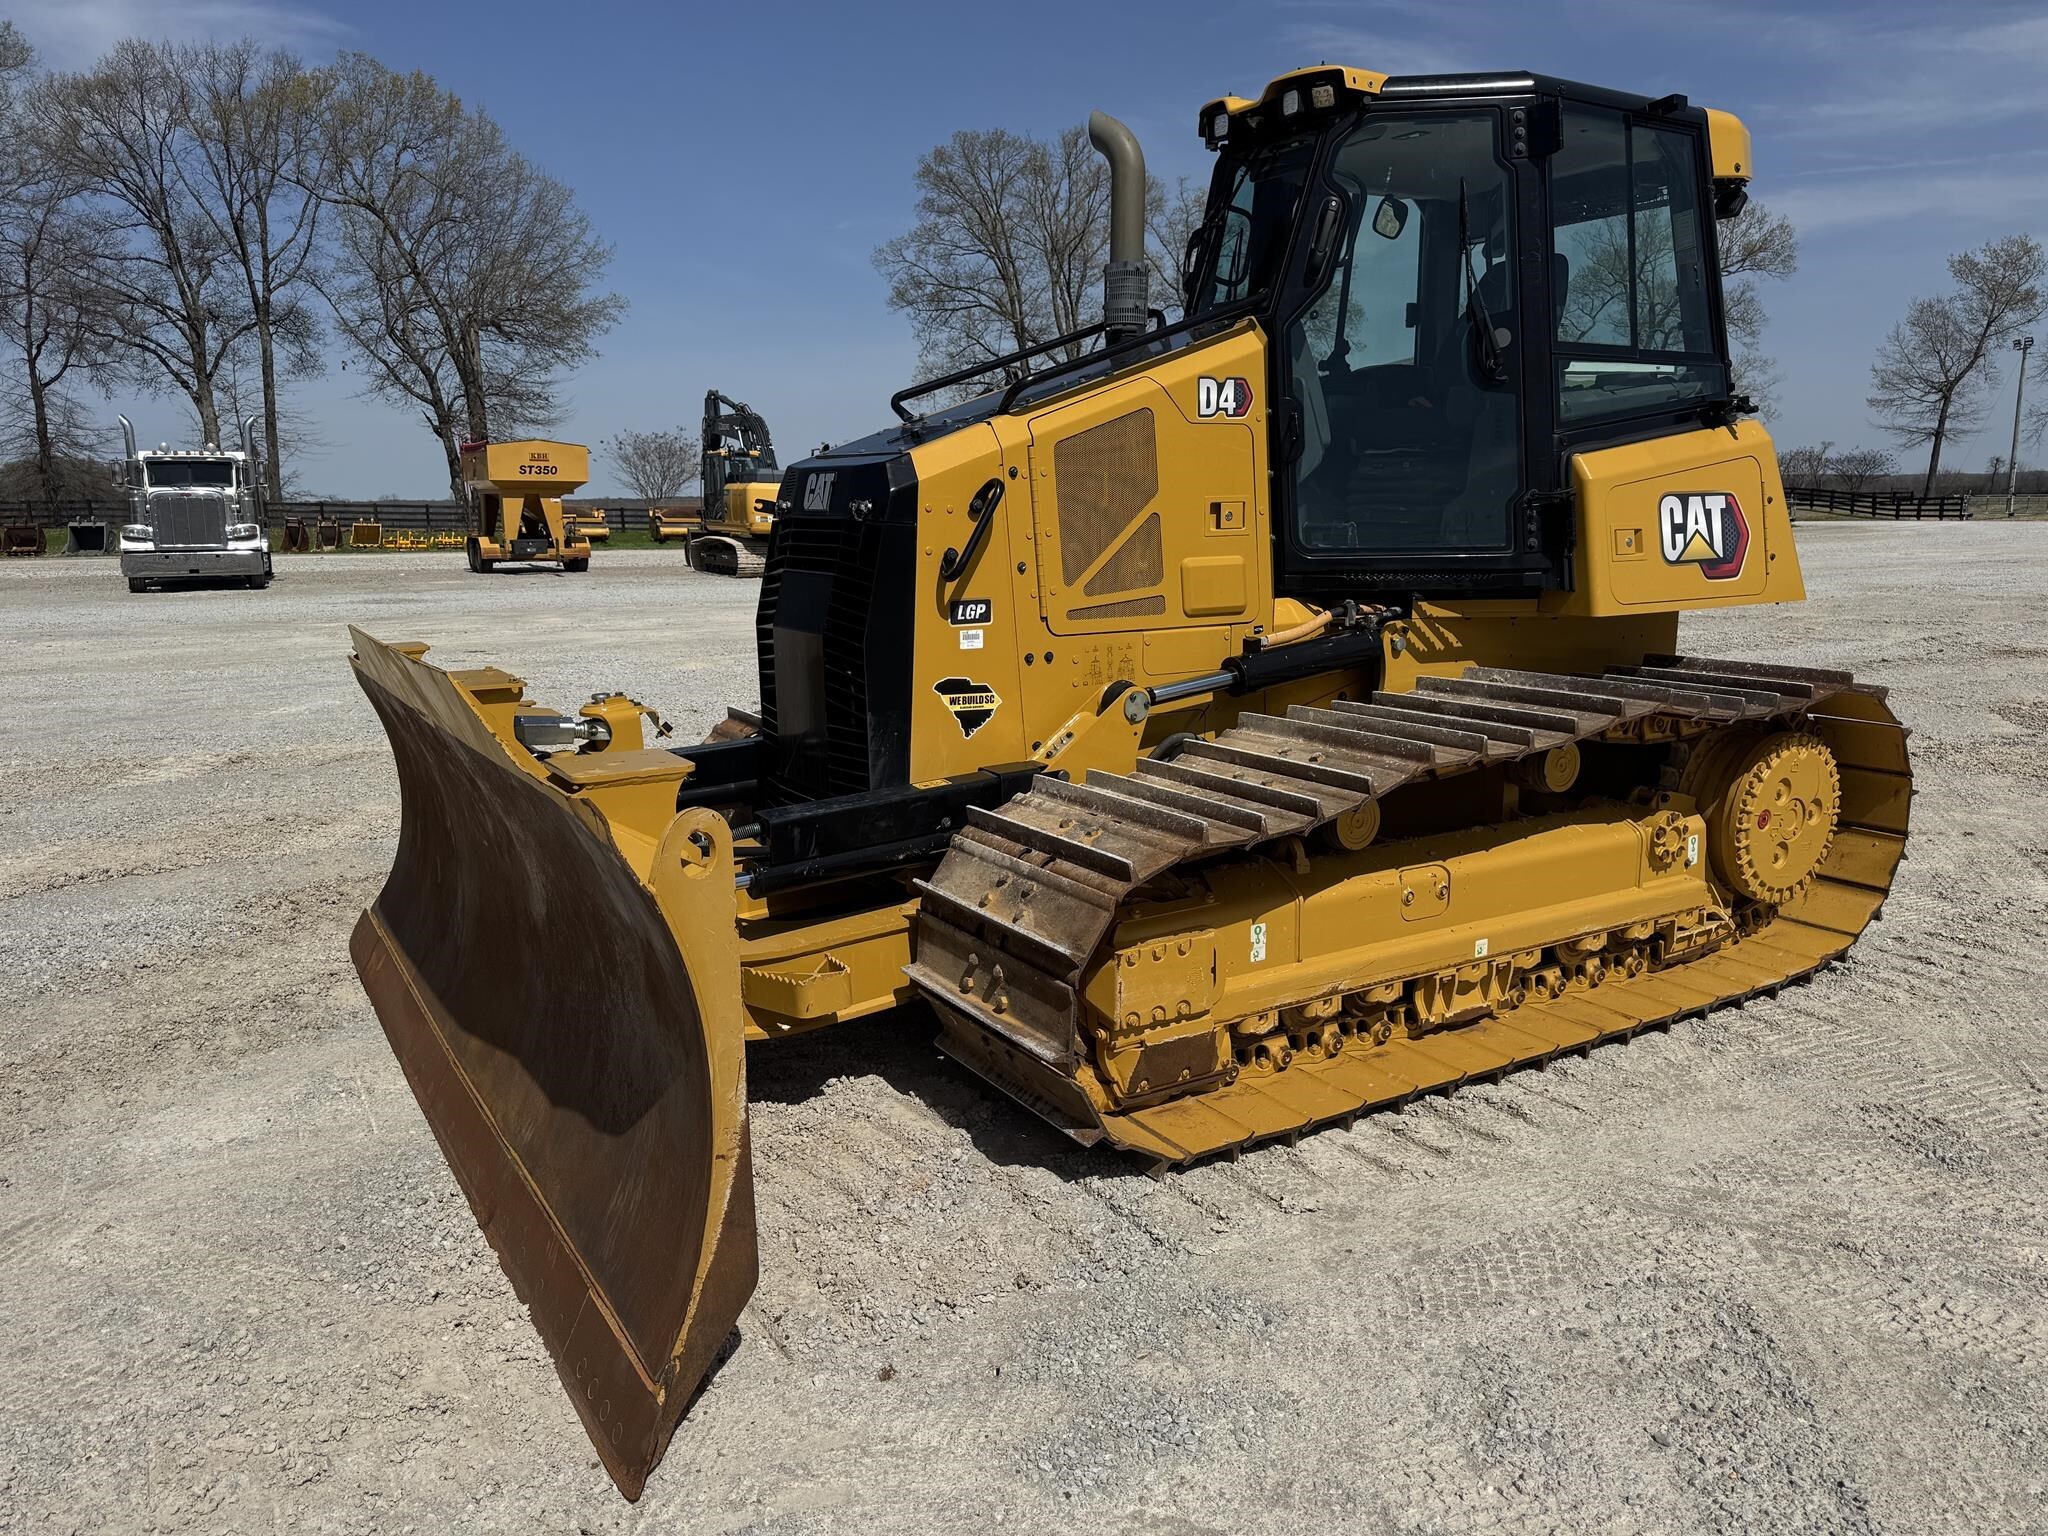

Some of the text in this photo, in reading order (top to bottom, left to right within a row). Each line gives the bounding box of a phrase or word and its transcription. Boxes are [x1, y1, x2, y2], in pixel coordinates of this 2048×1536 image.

[1199, 378, 1237, 415] D4
[518, 465, 558, 476] ST350
[803, 472, 836, 510] CAT
[1660, 495, 1727, 562] CAT
[957, 603, 987, 620] LGP
[949, 694, 995, 706] WE BUILD SC
